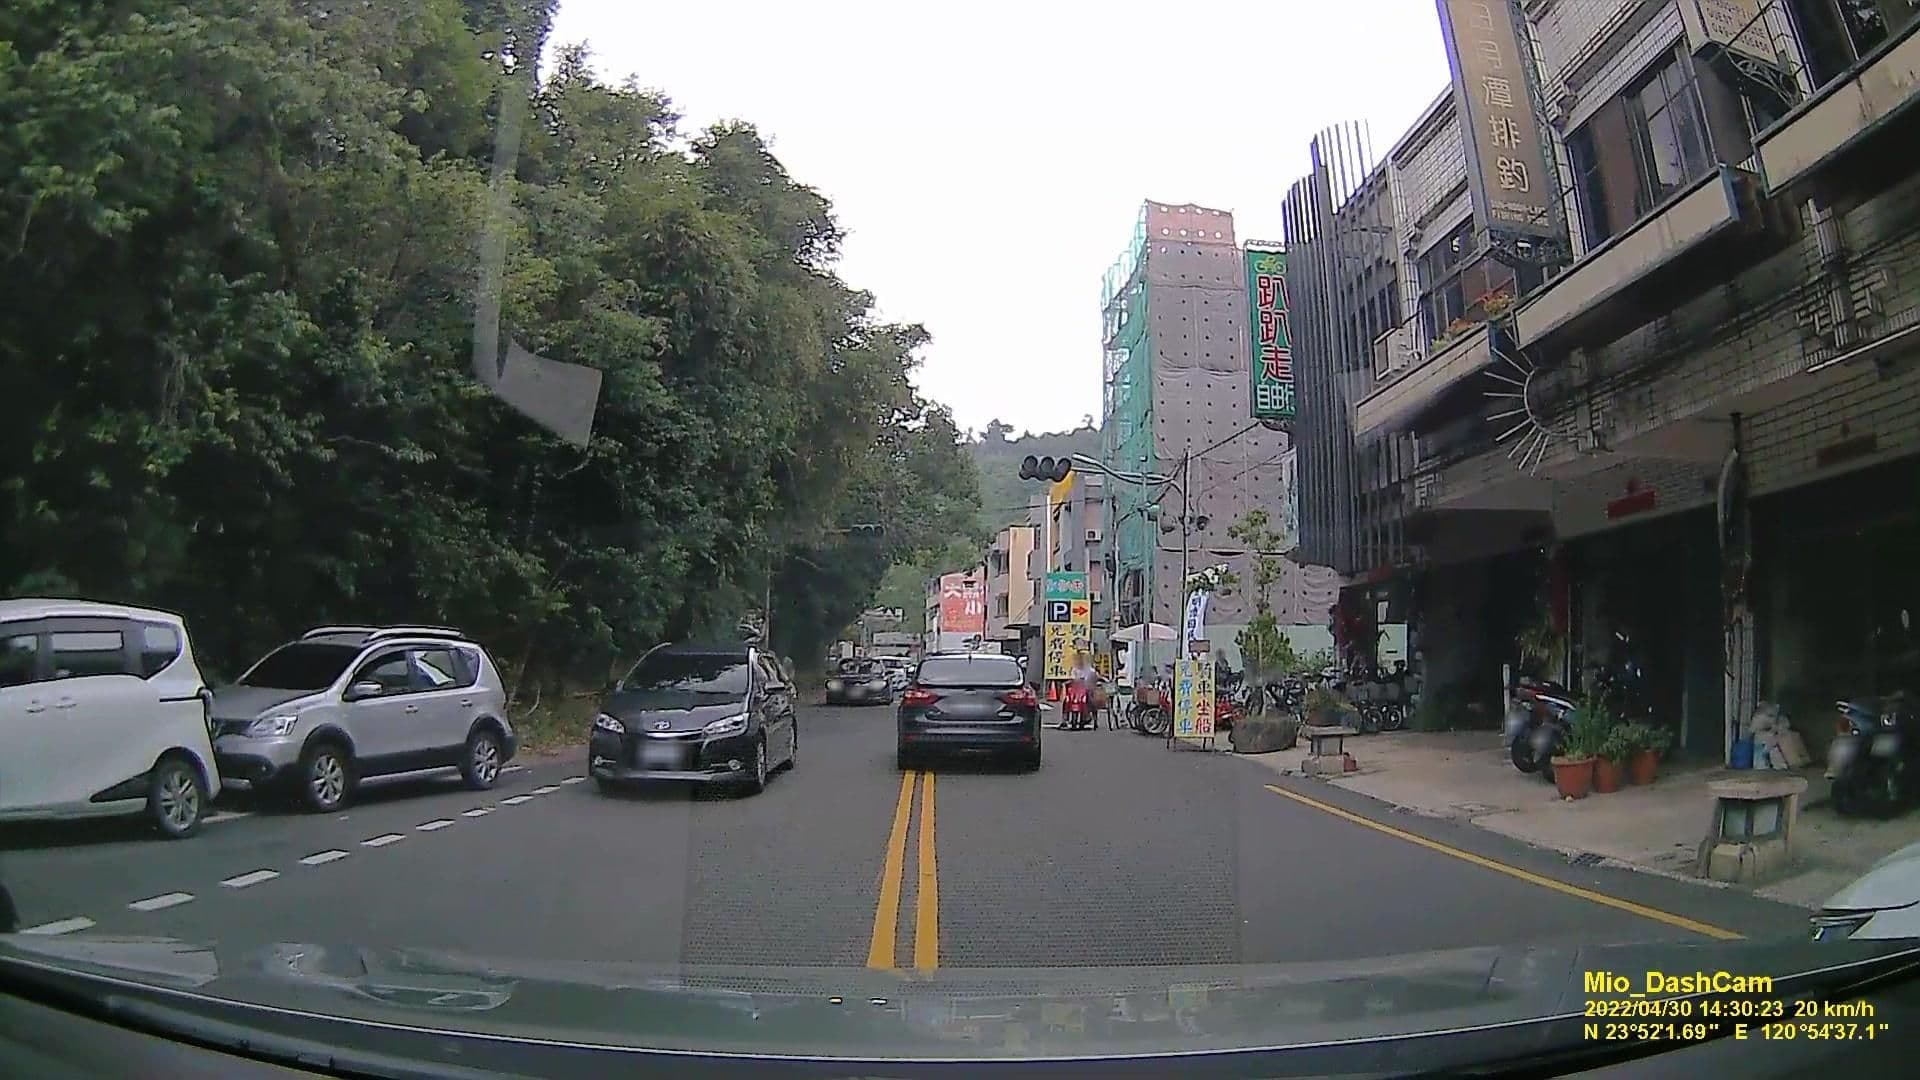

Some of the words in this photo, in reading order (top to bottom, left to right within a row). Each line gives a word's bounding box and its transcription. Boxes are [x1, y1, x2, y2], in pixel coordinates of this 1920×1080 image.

[1258, 275, 1295, 383] 趴趴走
[1053, 602, 1069, 621] P
